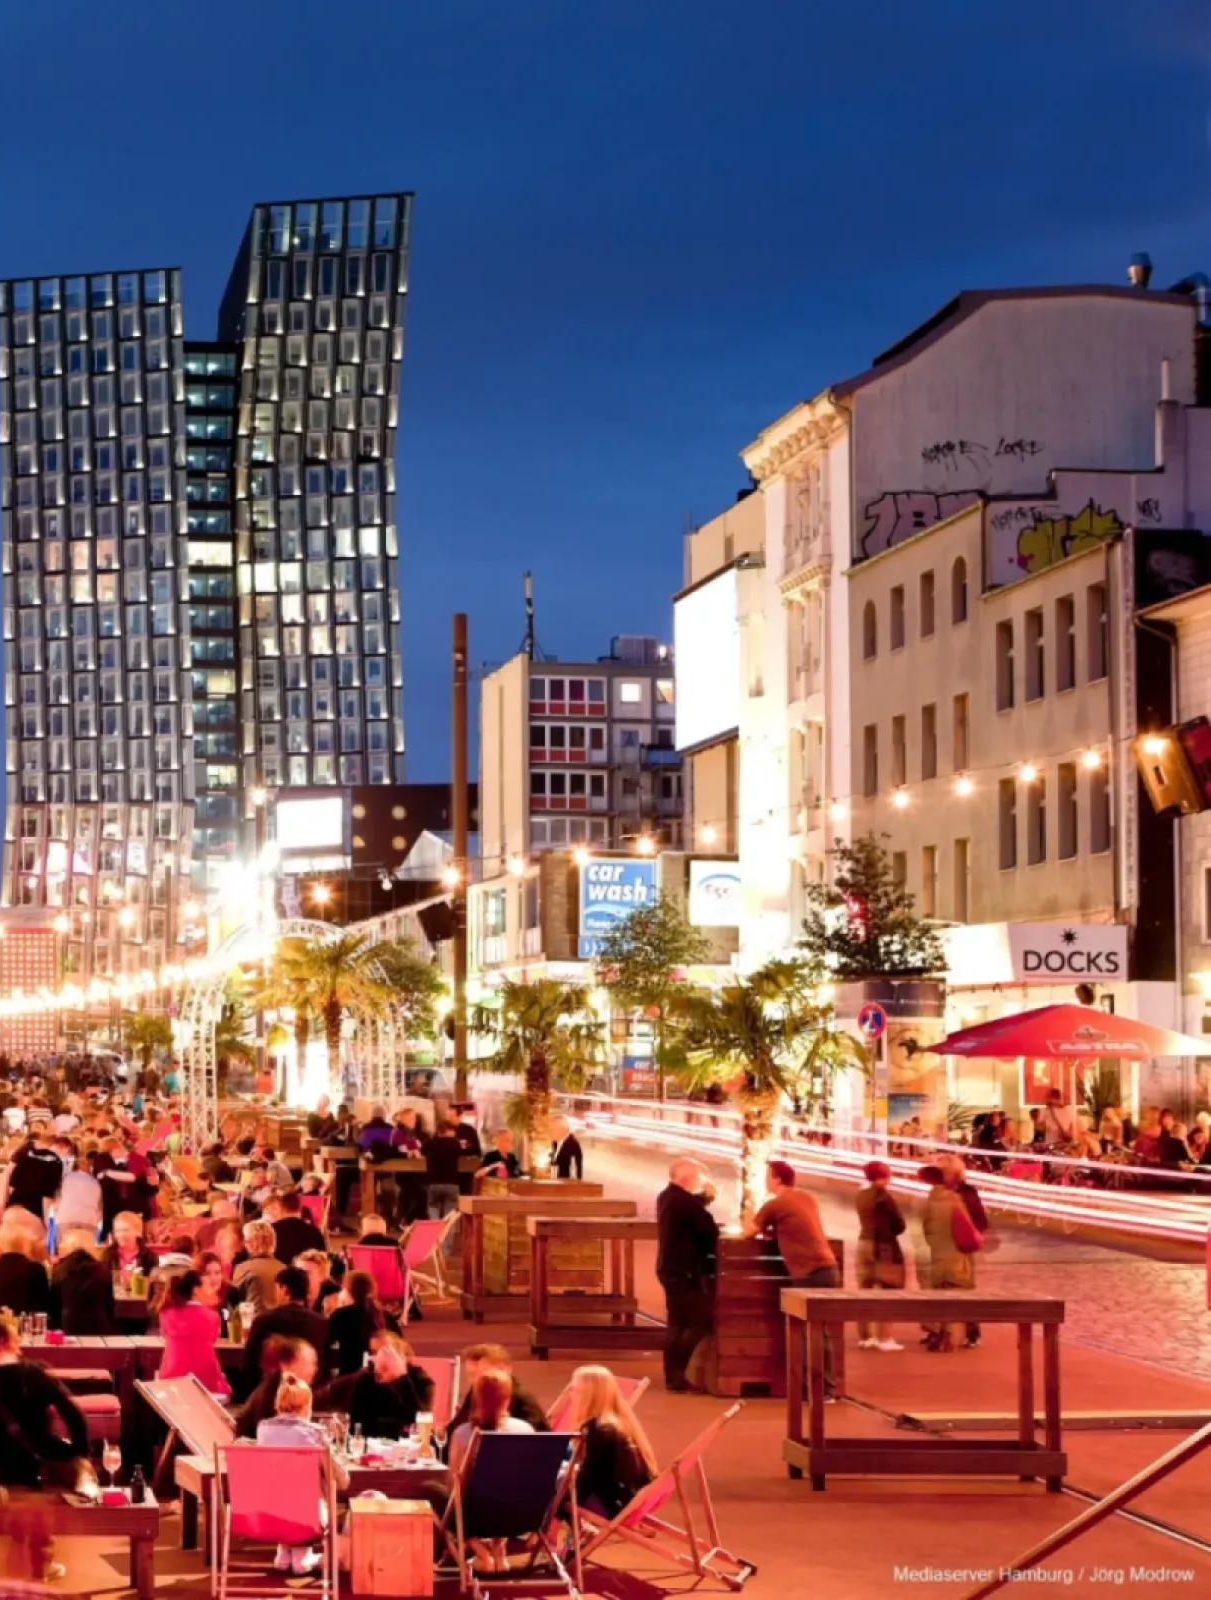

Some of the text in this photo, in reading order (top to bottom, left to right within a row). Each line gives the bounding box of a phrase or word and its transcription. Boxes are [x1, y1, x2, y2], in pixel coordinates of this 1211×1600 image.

[589, 864, 624, 882] car
[589, 877, 647, 902] wash
[1022, 950, 1120, 973] DOCKS
